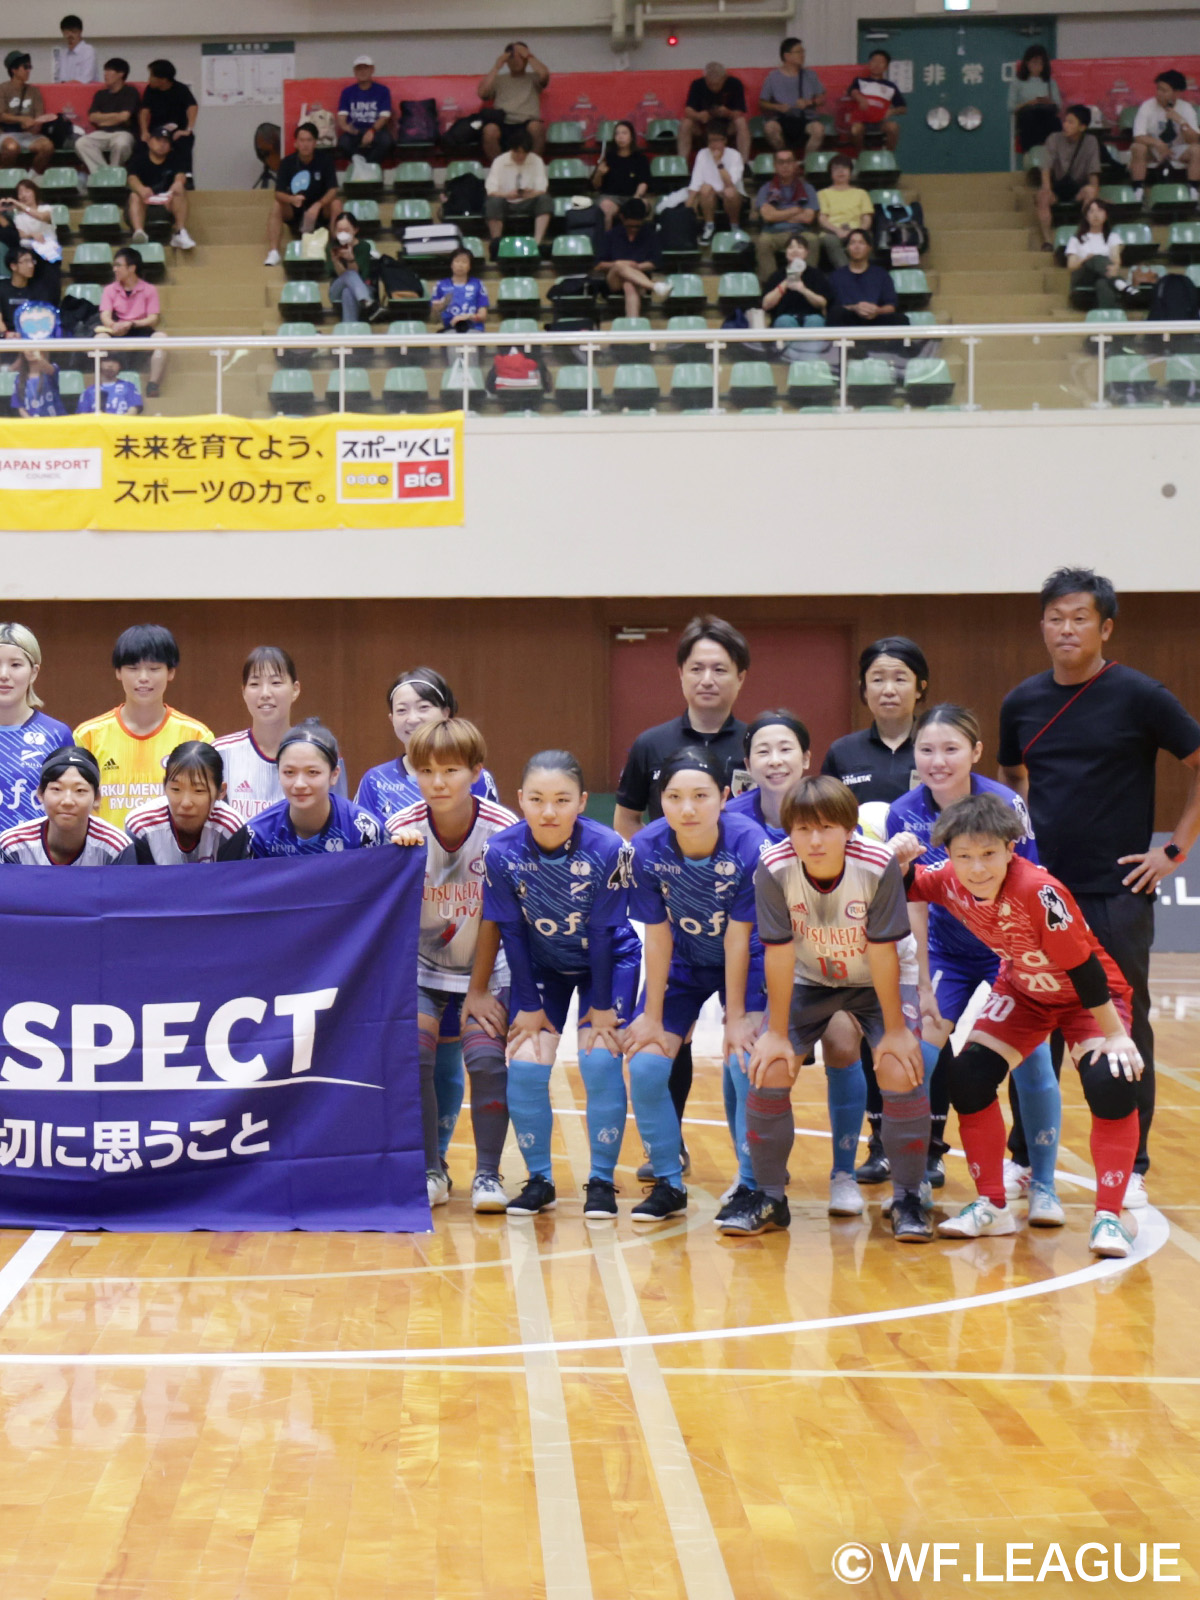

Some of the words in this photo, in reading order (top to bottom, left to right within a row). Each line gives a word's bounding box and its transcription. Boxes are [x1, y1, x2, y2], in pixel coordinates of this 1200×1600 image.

[114, 433, 324, 460] 未来を育てよう、
[342, 435, 450, 458] スポーツくじ
[45, 459, 91, 470] SPORT
[114, 478, 326, 504] スポーツの力で。
[101, 784, 126, 797] RKU
[817, 956, 849, 980] 13
[1019, 972, 1062, 992] 20
[982, 992, 1016, 1022] 20
